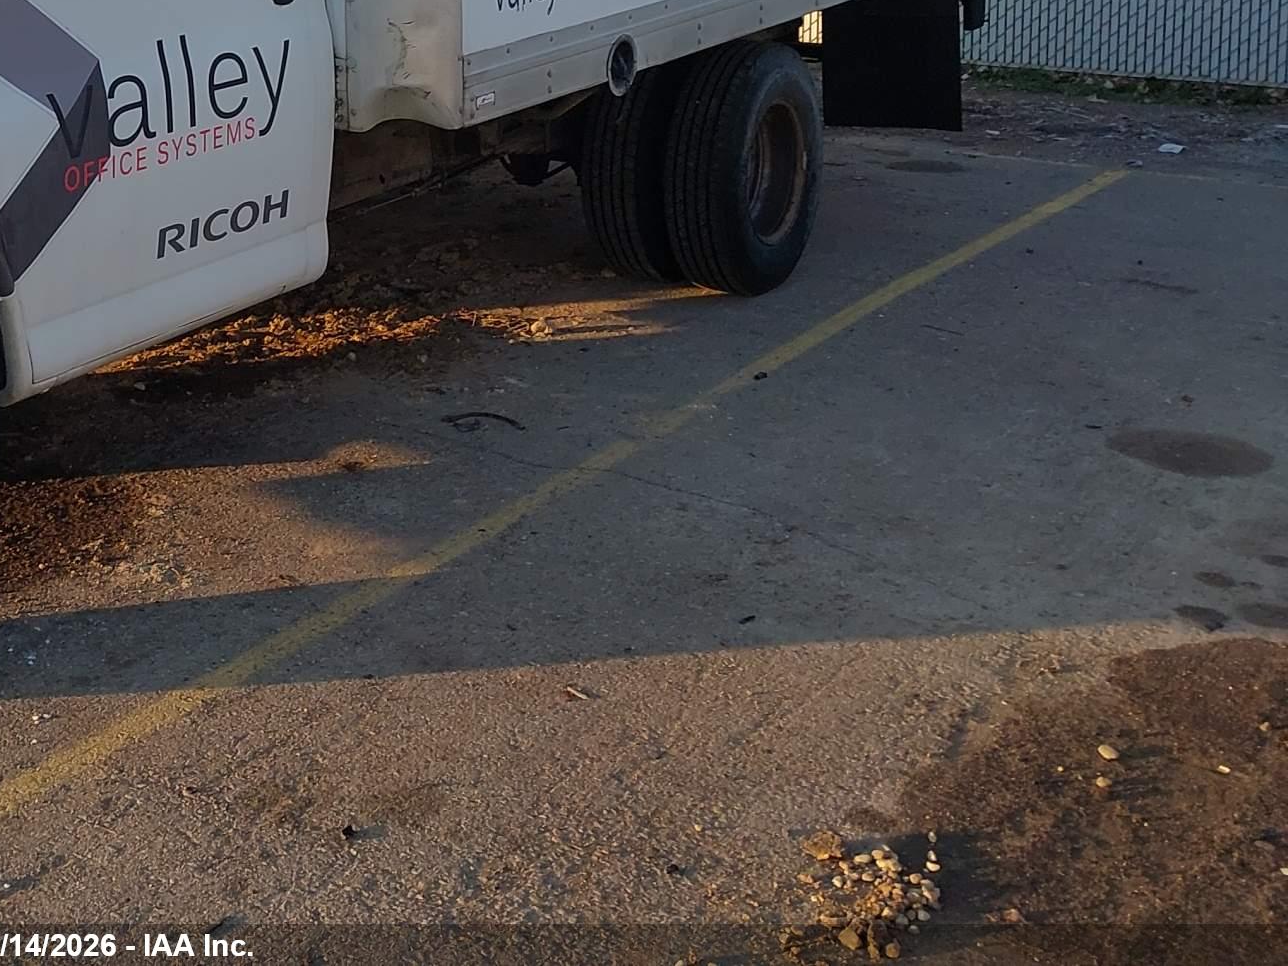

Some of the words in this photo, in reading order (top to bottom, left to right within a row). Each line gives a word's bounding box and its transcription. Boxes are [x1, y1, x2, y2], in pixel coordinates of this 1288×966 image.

[46, 34, 290, 158] valley
[63, 147, 148, 193] OFFICE
[157, 116, 256, 165] SYSTEMS
[156, 189, 290, 260] RICOH
